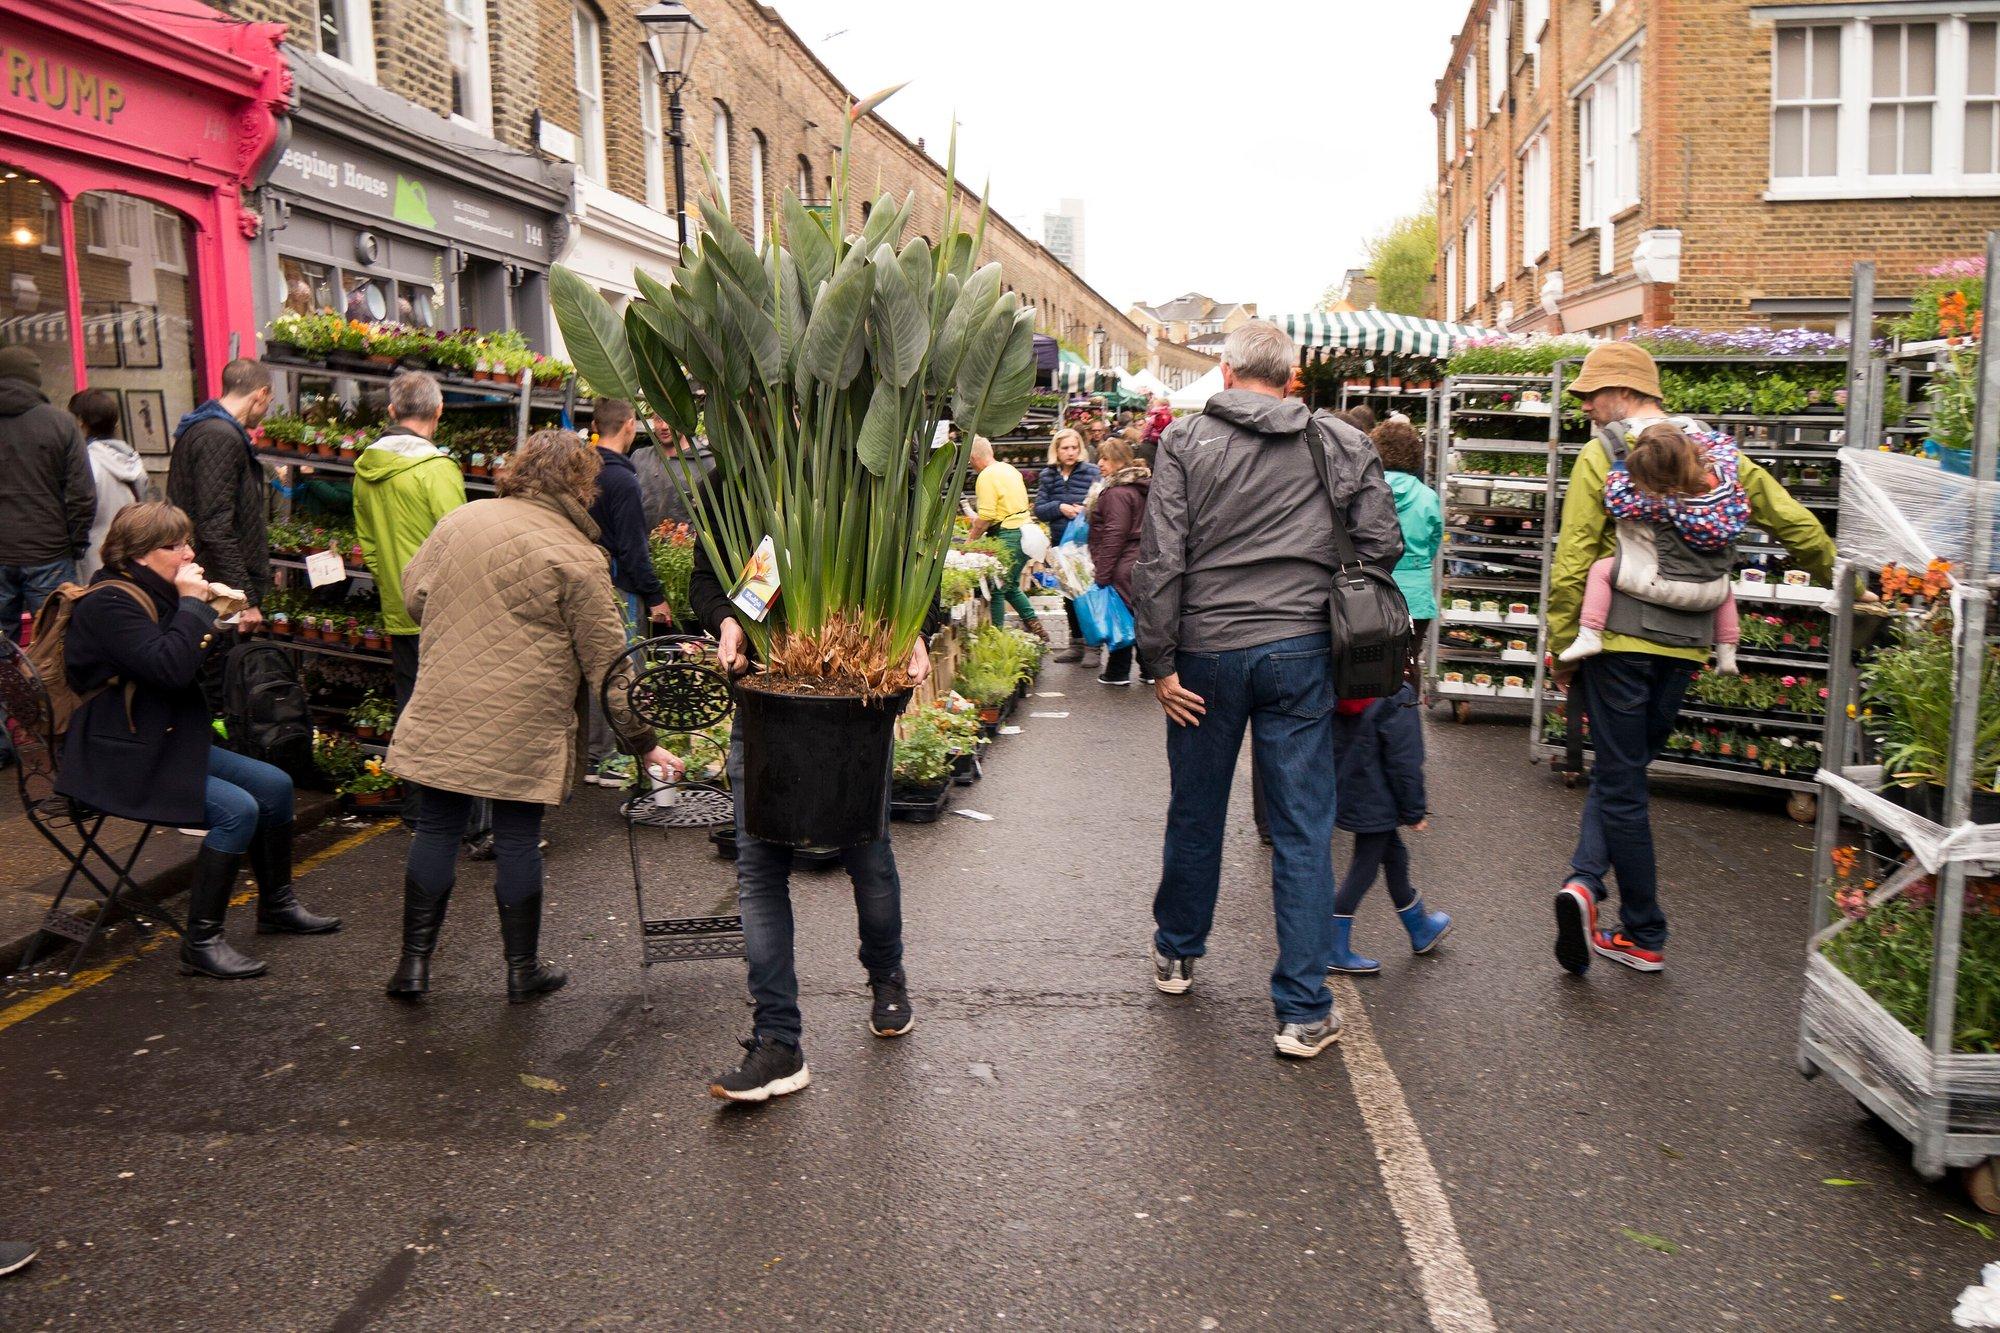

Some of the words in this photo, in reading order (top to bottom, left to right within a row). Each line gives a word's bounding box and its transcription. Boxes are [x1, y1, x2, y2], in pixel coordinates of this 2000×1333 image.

[0, 46, 125, 124] RUMP
[279, 148, 338, 188] eeping
[342, 162, 389, 198] House
[525, 224, 543, 247] 144
